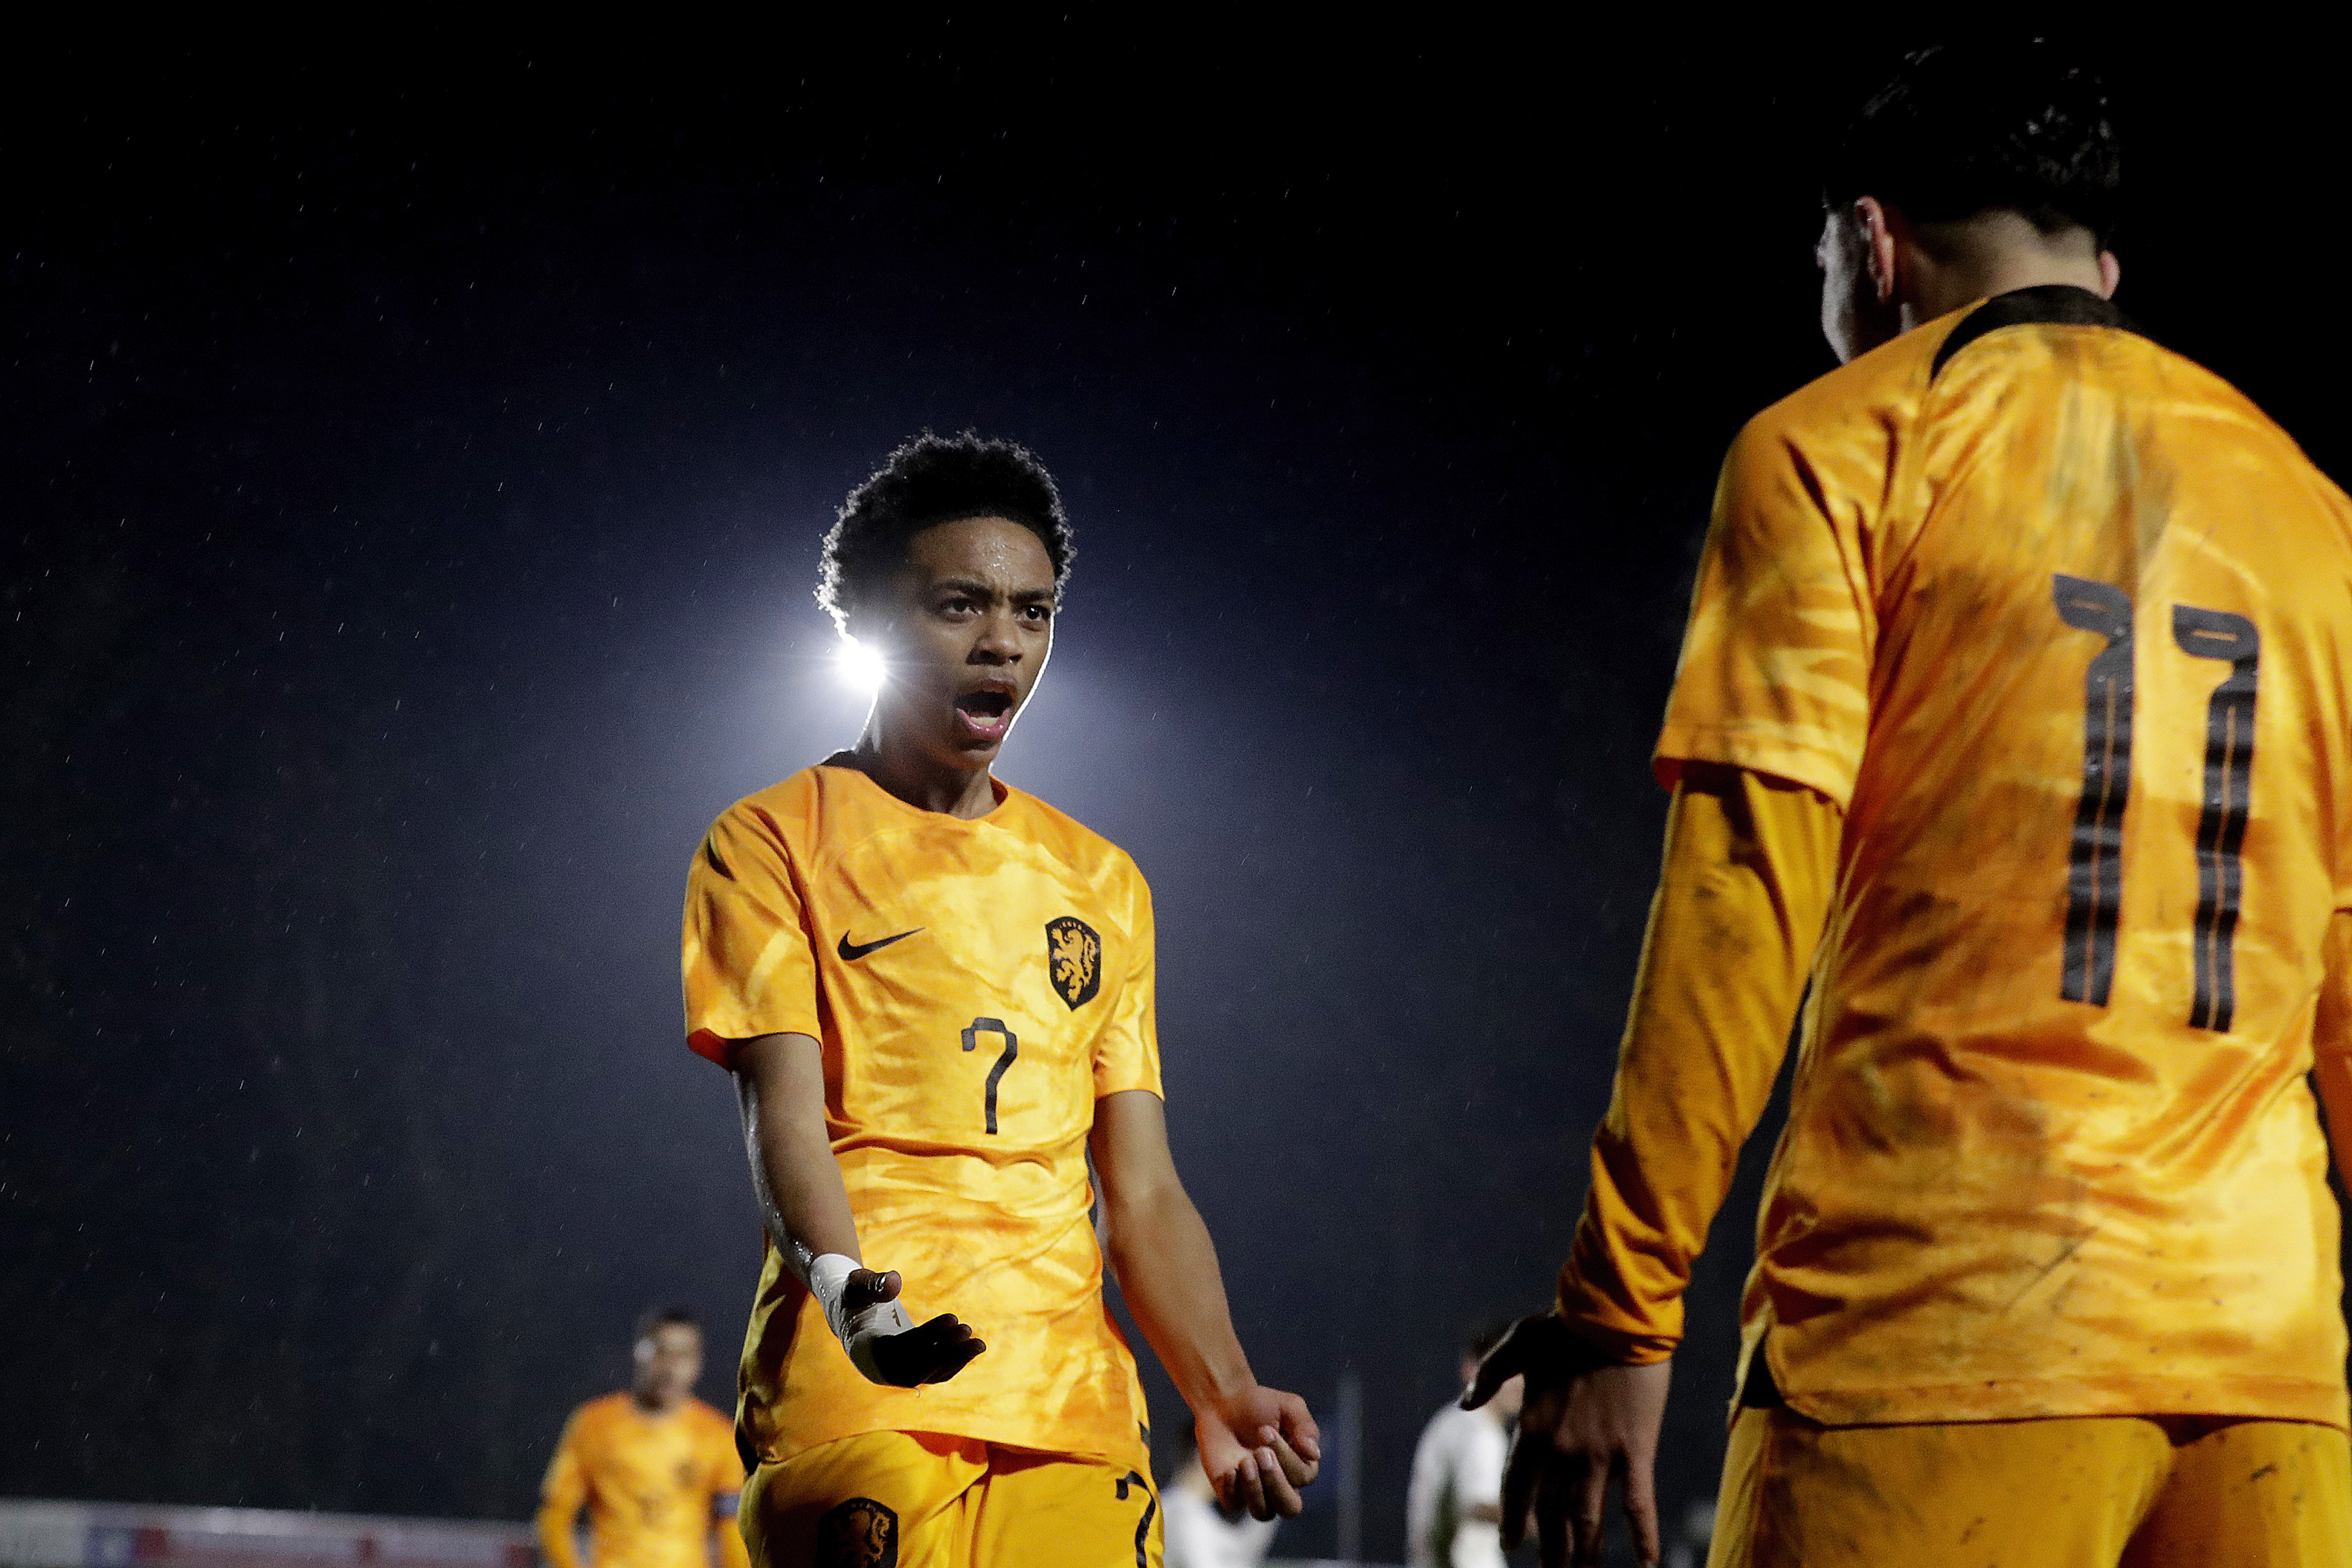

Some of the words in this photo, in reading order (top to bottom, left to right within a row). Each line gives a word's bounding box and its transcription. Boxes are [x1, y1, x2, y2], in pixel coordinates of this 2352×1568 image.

[2052, 574, 2260, 1033] 11
[961, 1017, 1017, 1134] 7
[1116, 1471, 1156, 1568] 7
